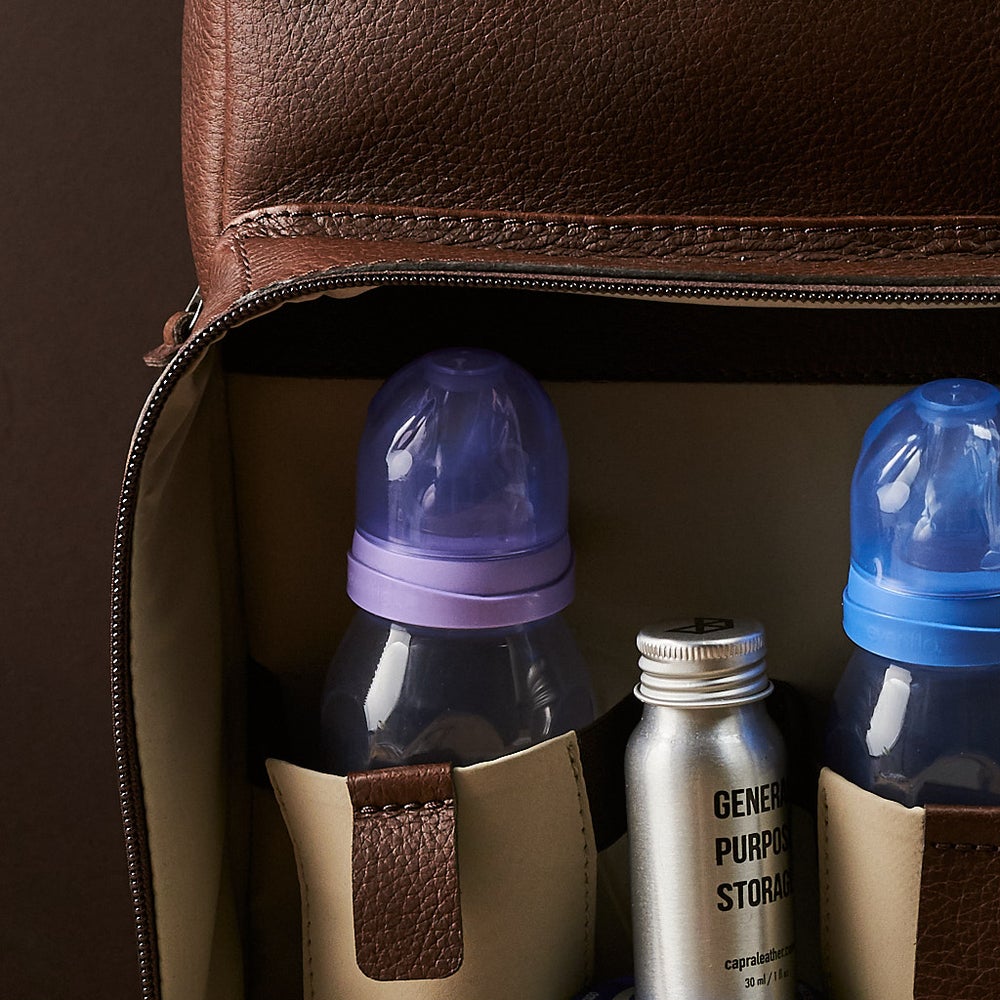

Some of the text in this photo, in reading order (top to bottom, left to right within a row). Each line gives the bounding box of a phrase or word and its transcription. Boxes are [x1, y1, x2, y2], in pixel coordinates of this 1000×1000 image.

[714, 777, 788, 819] GENERA
[715, 823, 791, 866] PURPOS
[745, 977, 755, 988] 30
[757, 972, 766, 986] ml
